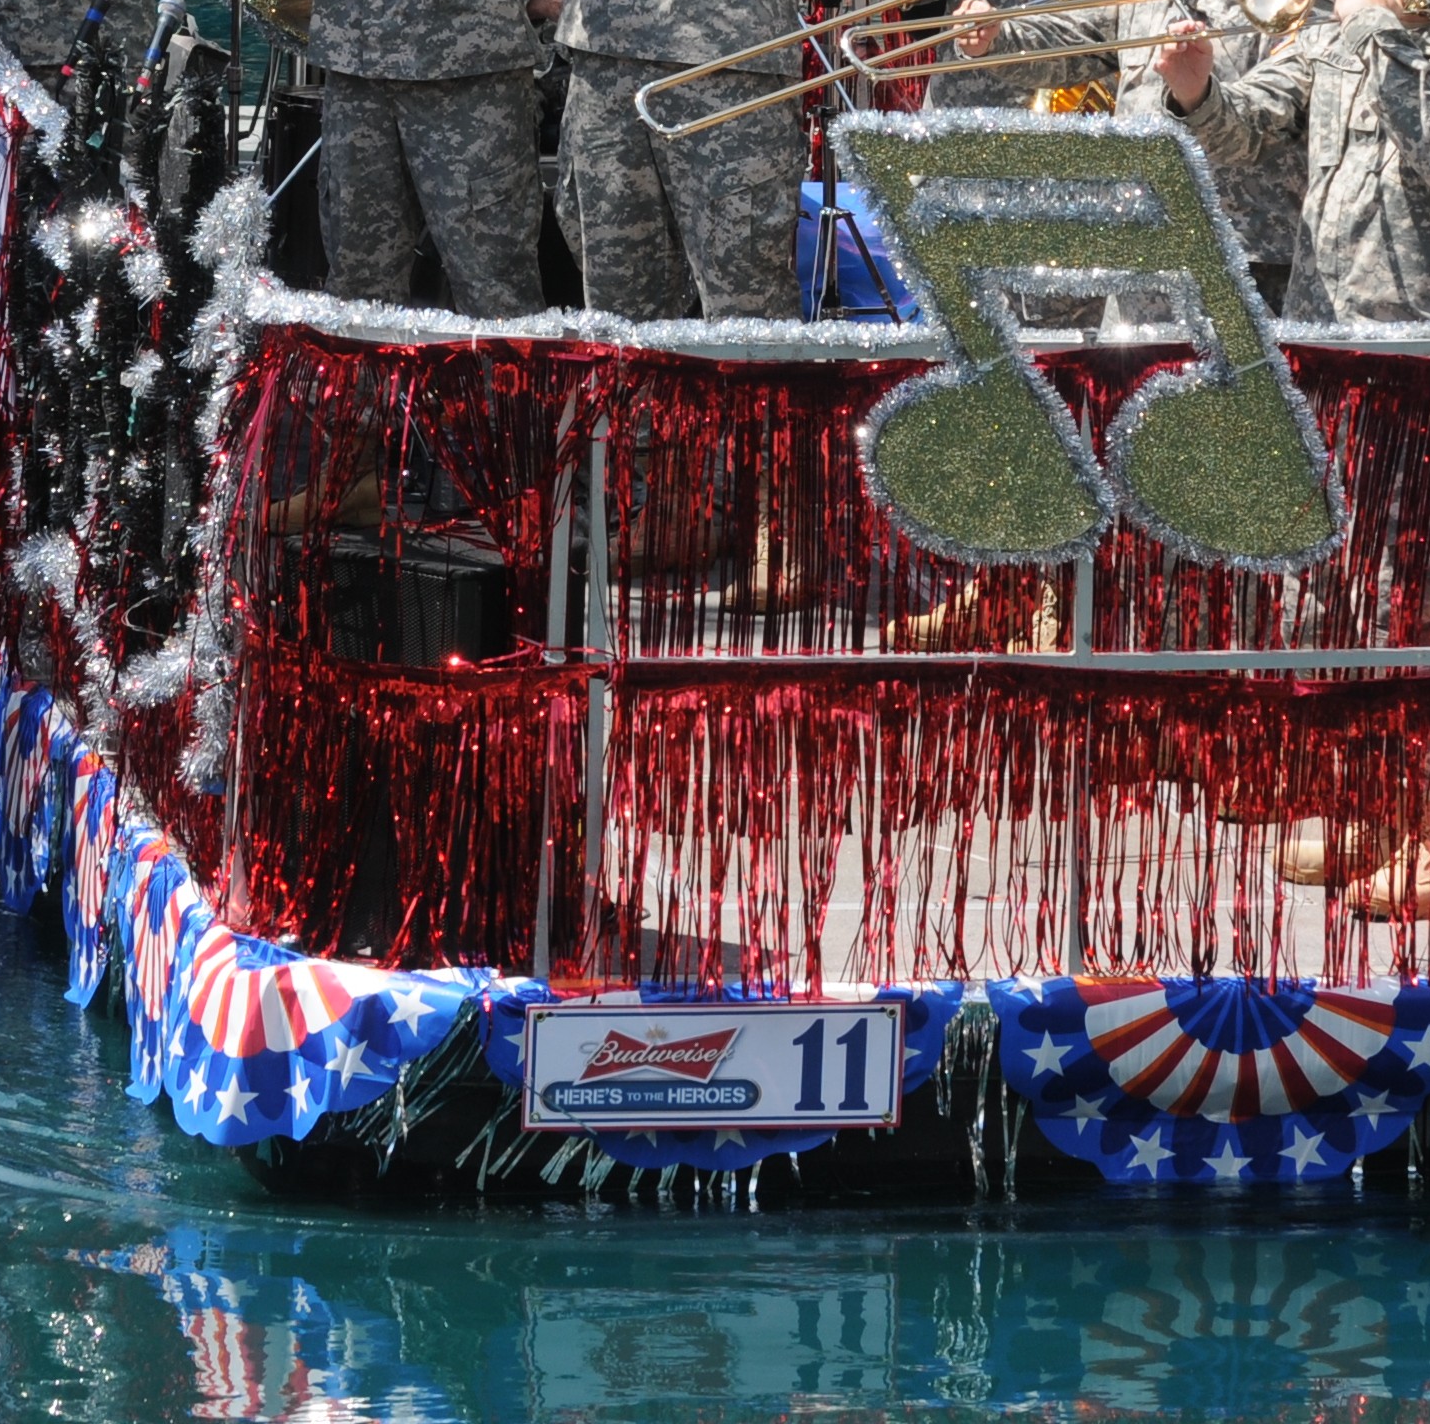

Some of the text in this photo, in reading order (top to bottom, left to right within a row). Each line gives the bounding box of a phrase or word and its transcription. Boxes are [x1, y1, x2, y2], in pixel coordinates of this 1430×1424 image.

[1320, 48, 1357, 68] TAYLOR
[578, 1016, 870, 1112] Budweiser 11
[554, 1086, 747, 1106] HERE'S TO THE HEROES
